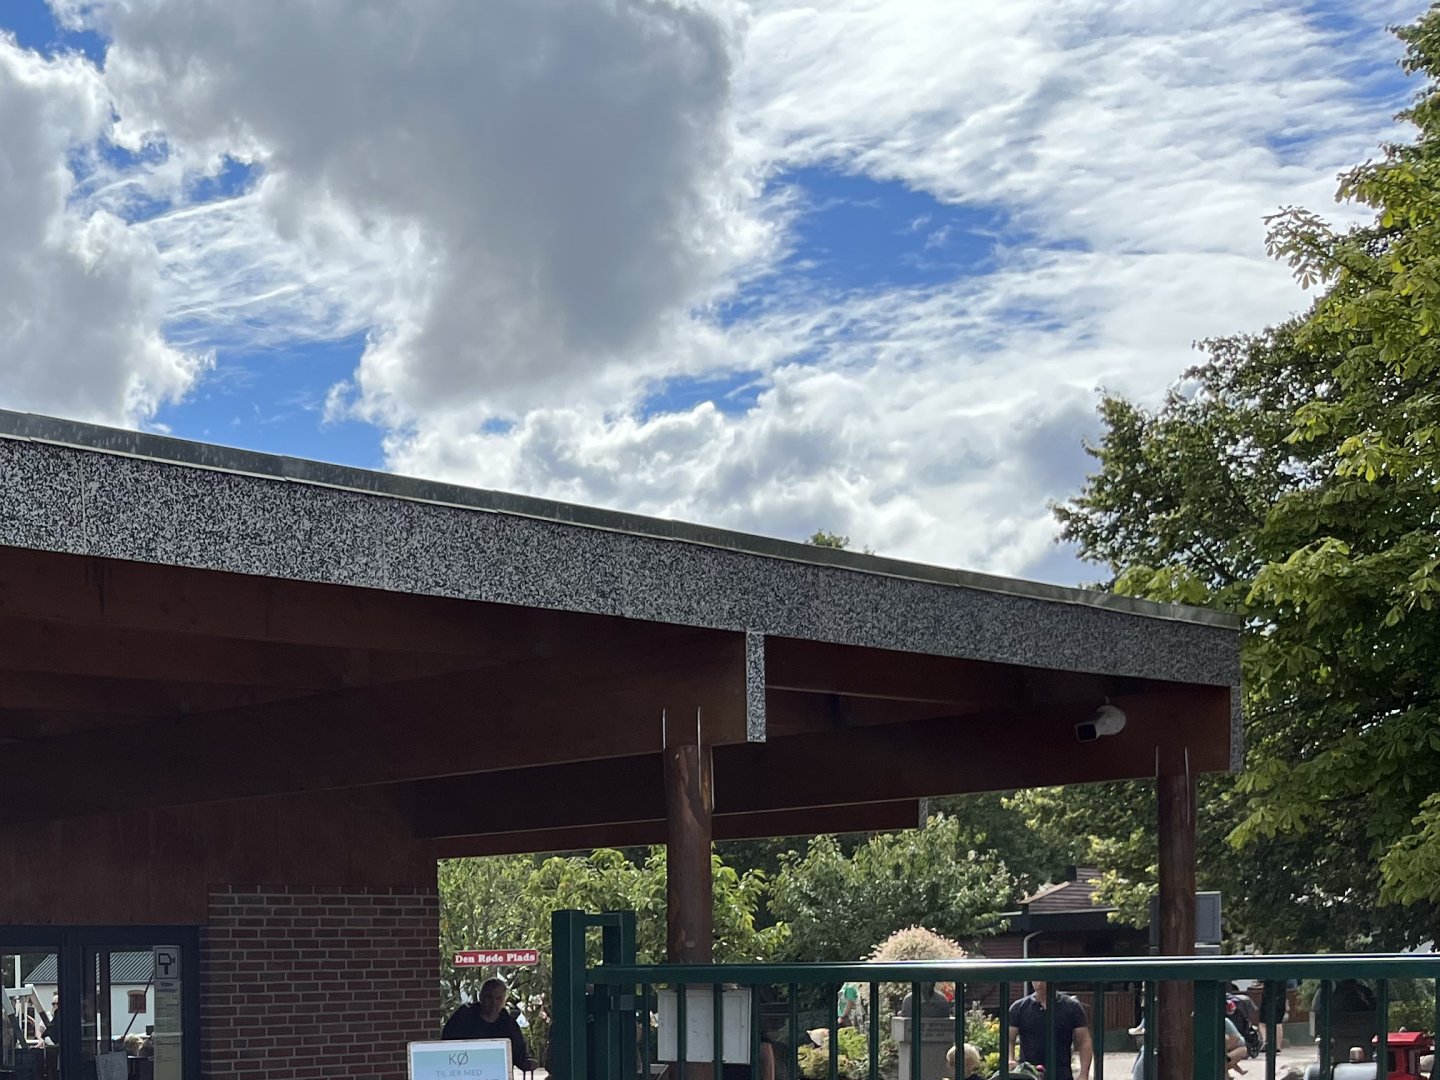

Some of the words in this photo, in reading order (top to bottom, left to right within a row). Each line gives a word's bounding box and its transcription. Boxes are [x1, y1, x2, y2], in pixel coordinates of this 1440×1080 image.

[455, 954, 475, 964] Den
[478, 953, 504, 964] Røde
[506, 952, 535, 962] Plads
[448, 1050, 469, 1067] KØ
[435, 1070, 446, 1078] TIL
[464, 1069, 483, 1077] MED
